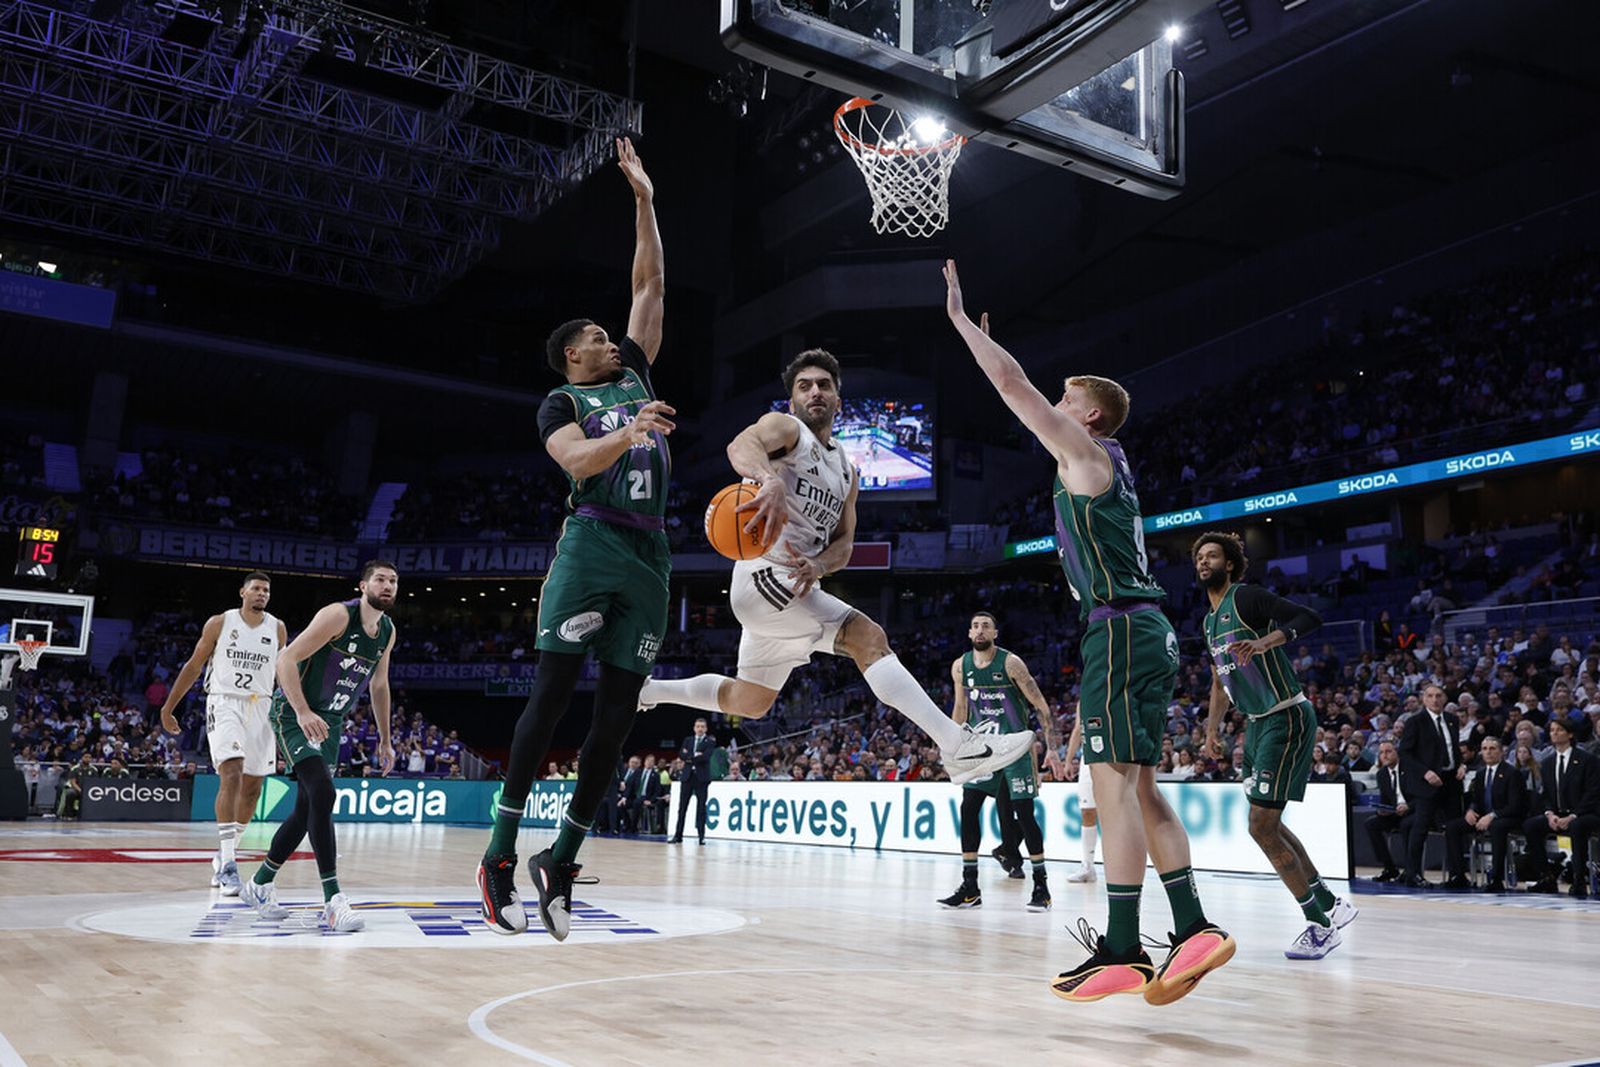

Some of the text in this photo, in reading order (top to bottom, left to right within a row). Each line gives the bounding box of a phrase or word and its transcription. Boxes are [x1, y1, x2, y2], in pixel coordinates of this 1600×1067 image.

[1446, 450, 1515, 474] SKODA
[628, 469, 652, 500] 21
[1337, 472, 1399, 494] SKODA
[1243, 492, 1298, 512] SKODA
[1155, 510, 1203, 528] SKODA
[32, 527, 60, 543] 8:54
[32, 543, 55, 565] 15
[138, 529, 360, 571] BERSERKERS
[1015, 539, 1054, 555] SKODA
[226, 648, 270, 664] Emirates
[234, 672, 253, 689] 22
[393, 663, 497, 678] RSERKERS
[328, 692, 350, 711] 13
[88, 782, 181, 802] endesa
[332, 780, 447, 823] nicaja
[523, 783, 574, 828] nicaja
[728, 790, 857, 846] atreves,
[870, 801, 892, 850] y
[903, 787, 935, 840] la
